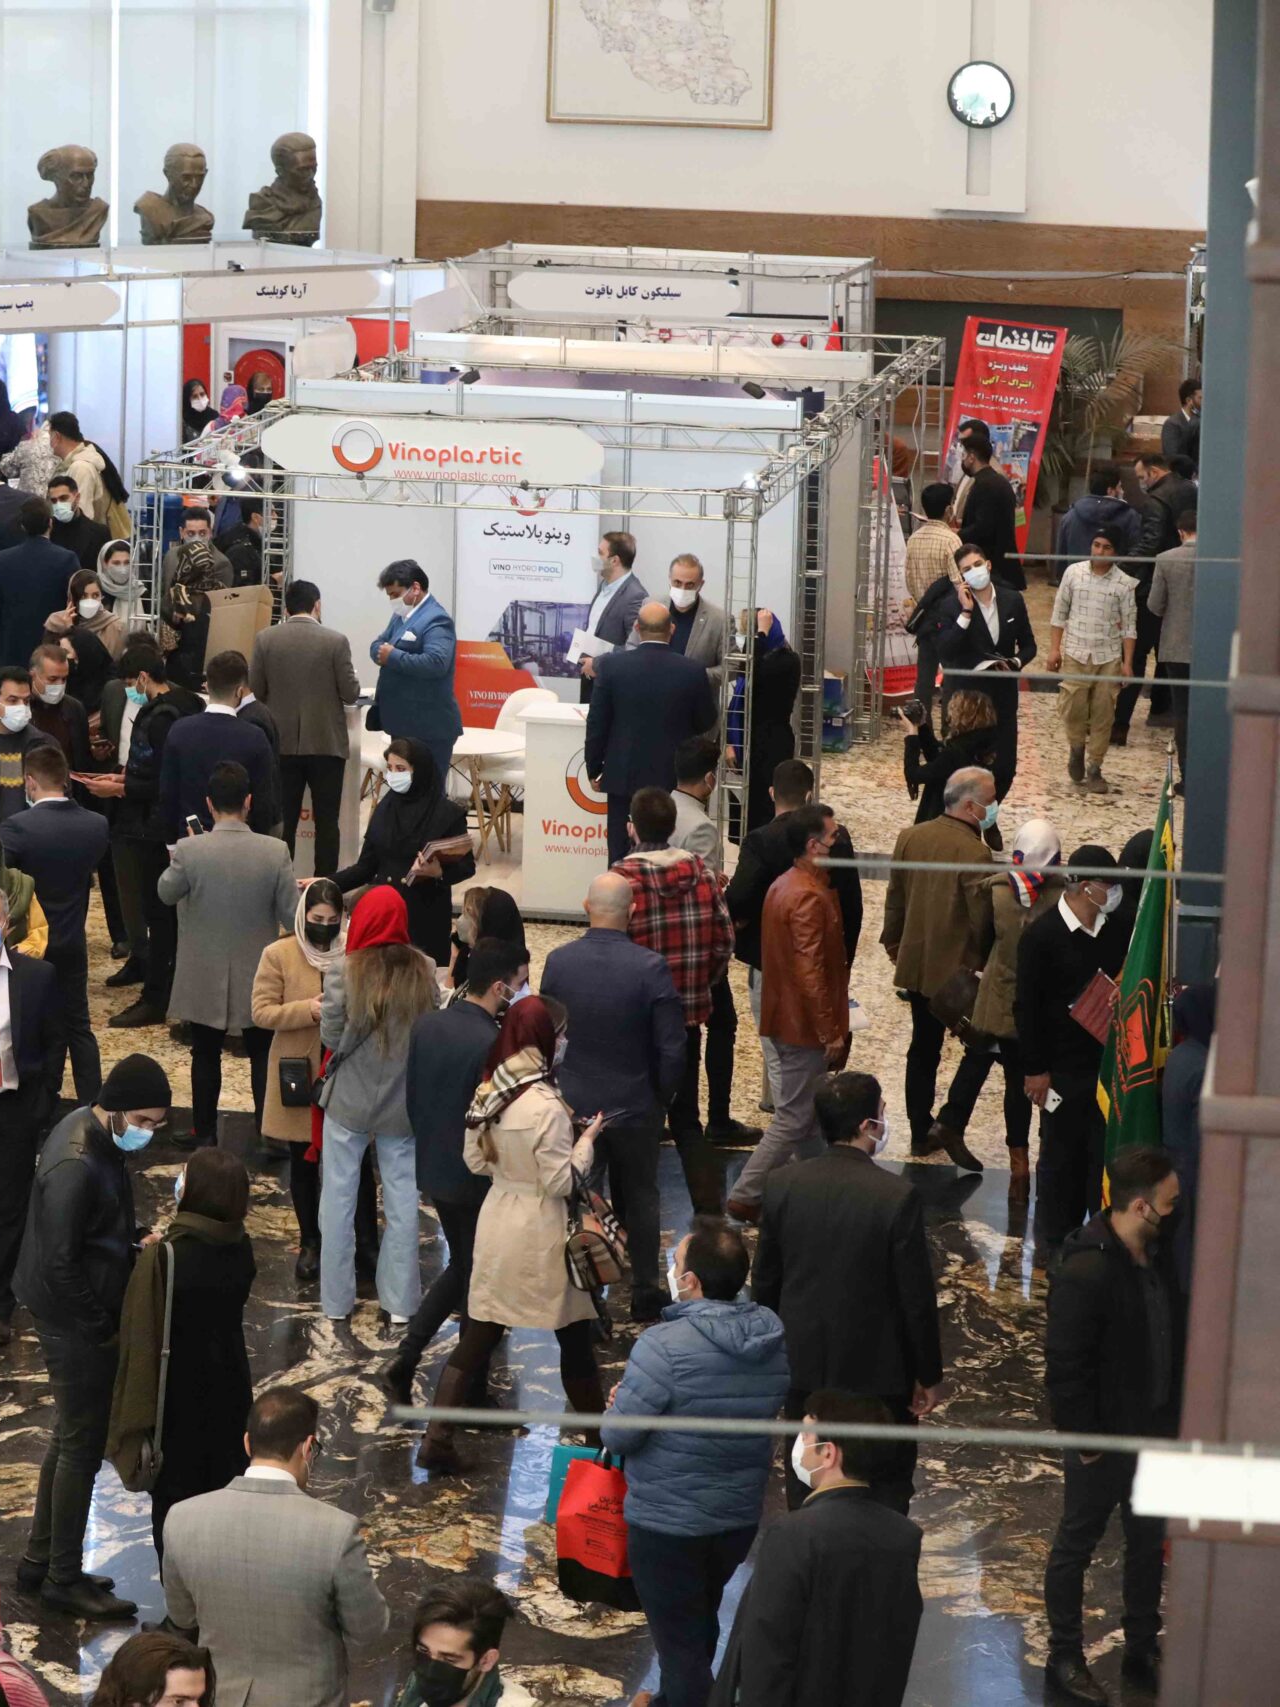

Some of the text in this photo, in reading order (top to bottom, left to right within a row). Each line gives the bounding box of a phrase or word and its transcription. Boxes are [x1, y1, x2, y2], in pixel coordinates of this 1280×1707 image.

[585, 284, 682, 301] سیلیکون کابل یاقوت
[975, 326, 1055, 355] ساختمان
[388, 442, 522, 468] Vinoplastic
[393, 468, 517, 484] www.vinoplastic.com
[483, 522, 571, 546] وینوپلاستیک
[492, 563, 511, 572] VINO
[538, 565, 560, 574] POOL
[469, 690, 487, 700] VINO
